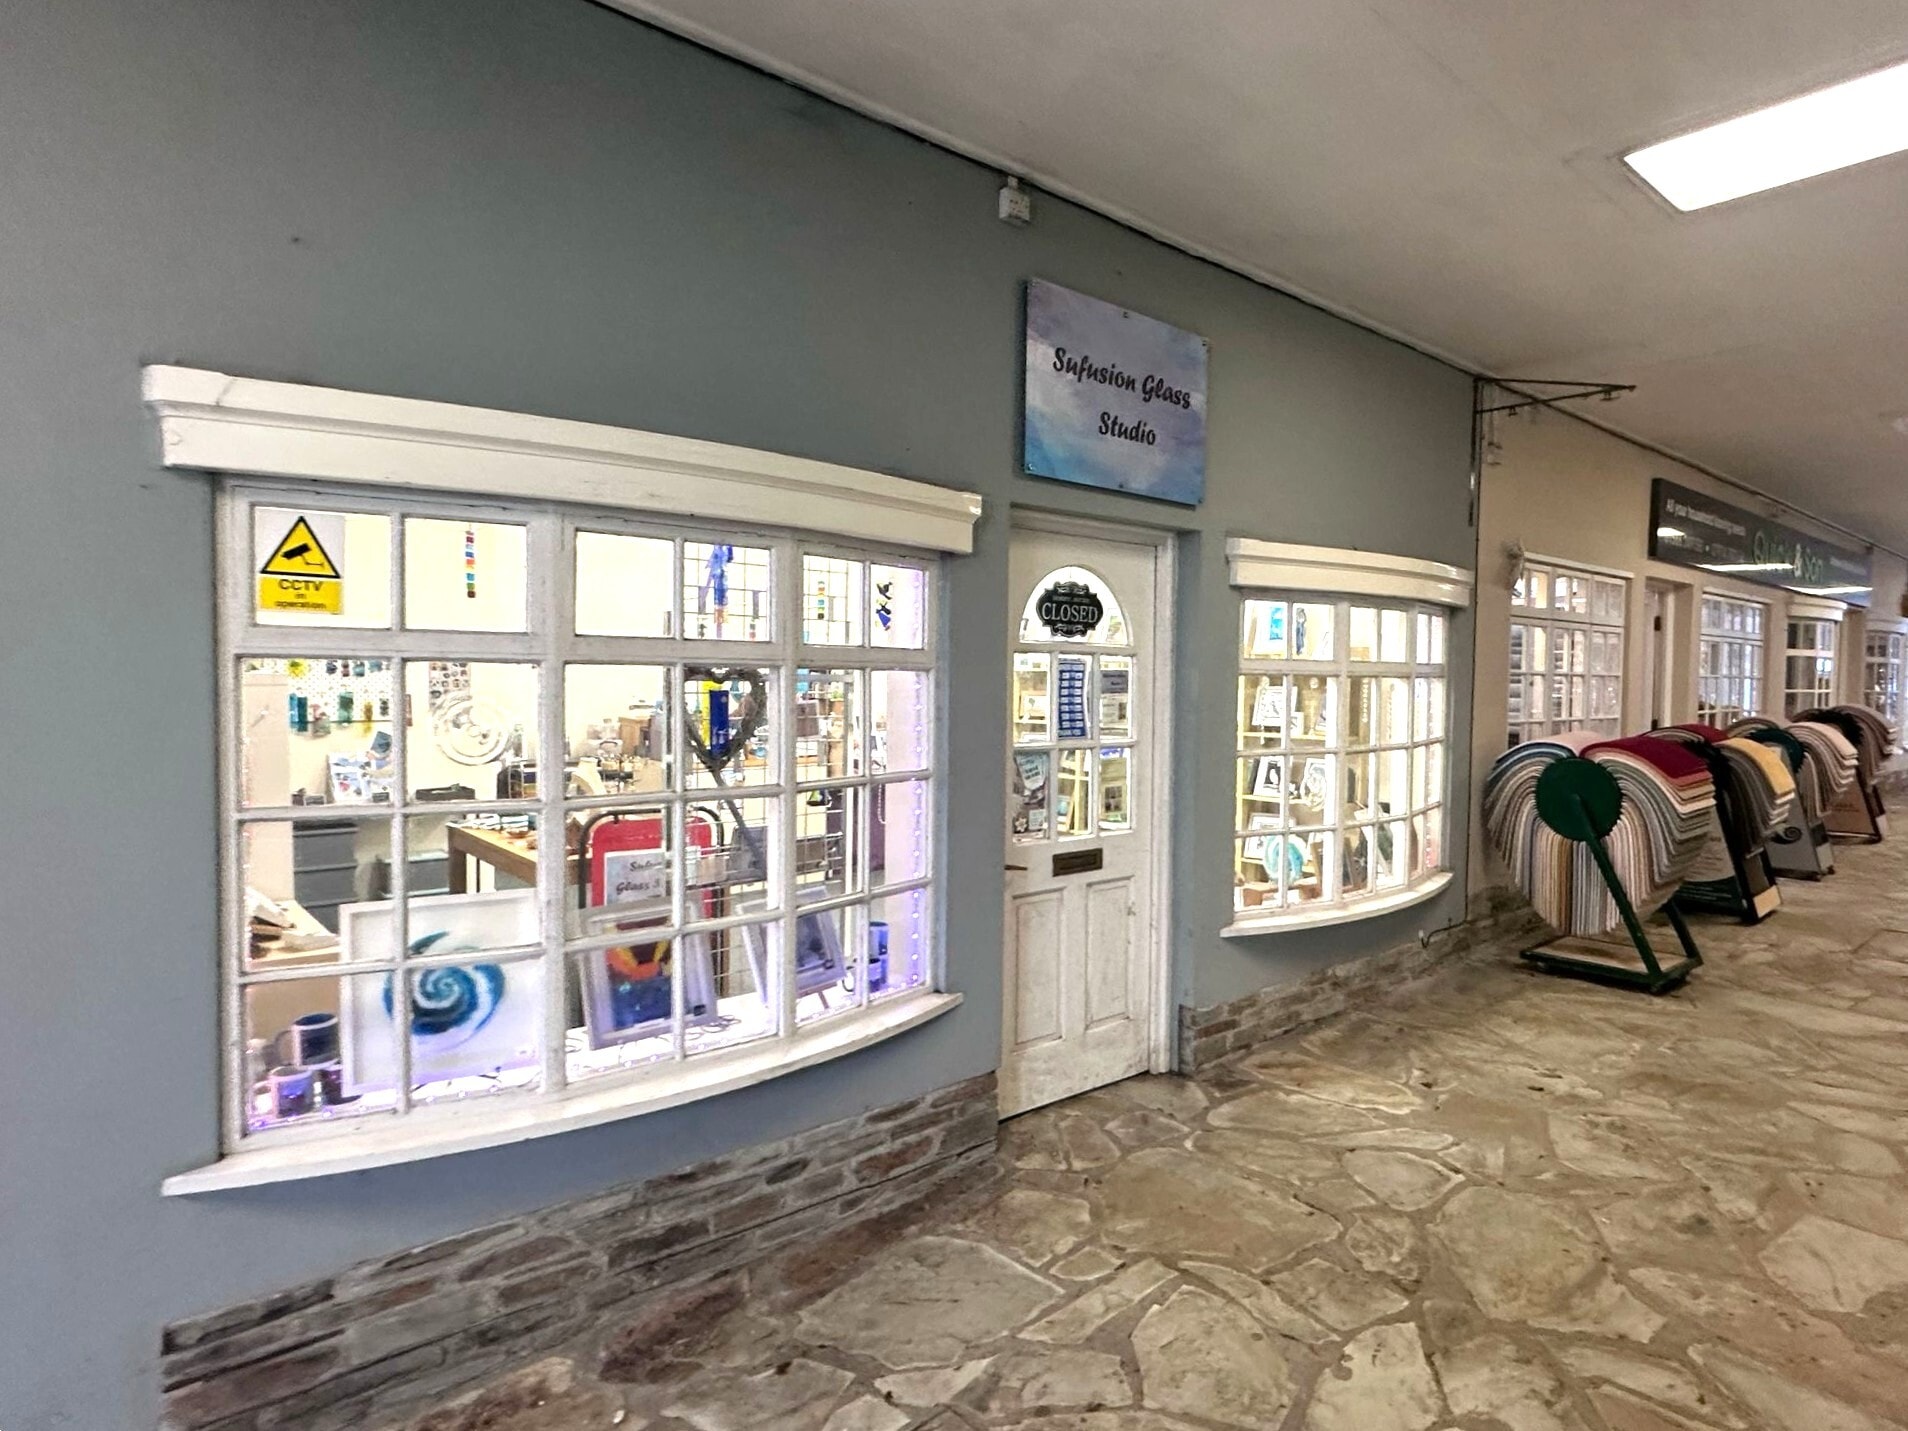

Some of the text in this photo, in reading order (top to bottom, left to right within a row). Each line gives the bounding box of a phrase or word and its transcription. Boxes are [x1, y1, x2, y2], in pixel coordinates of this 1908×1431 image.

[1053, 347, 1191, 410] Sufusion Glass
[1098, 411, 1156, 446] Studio
[278, 578, 324, 591] CCTV
[274, 601, 327, 610] operation
[1041, 602, 1099, 623] CLOSED
